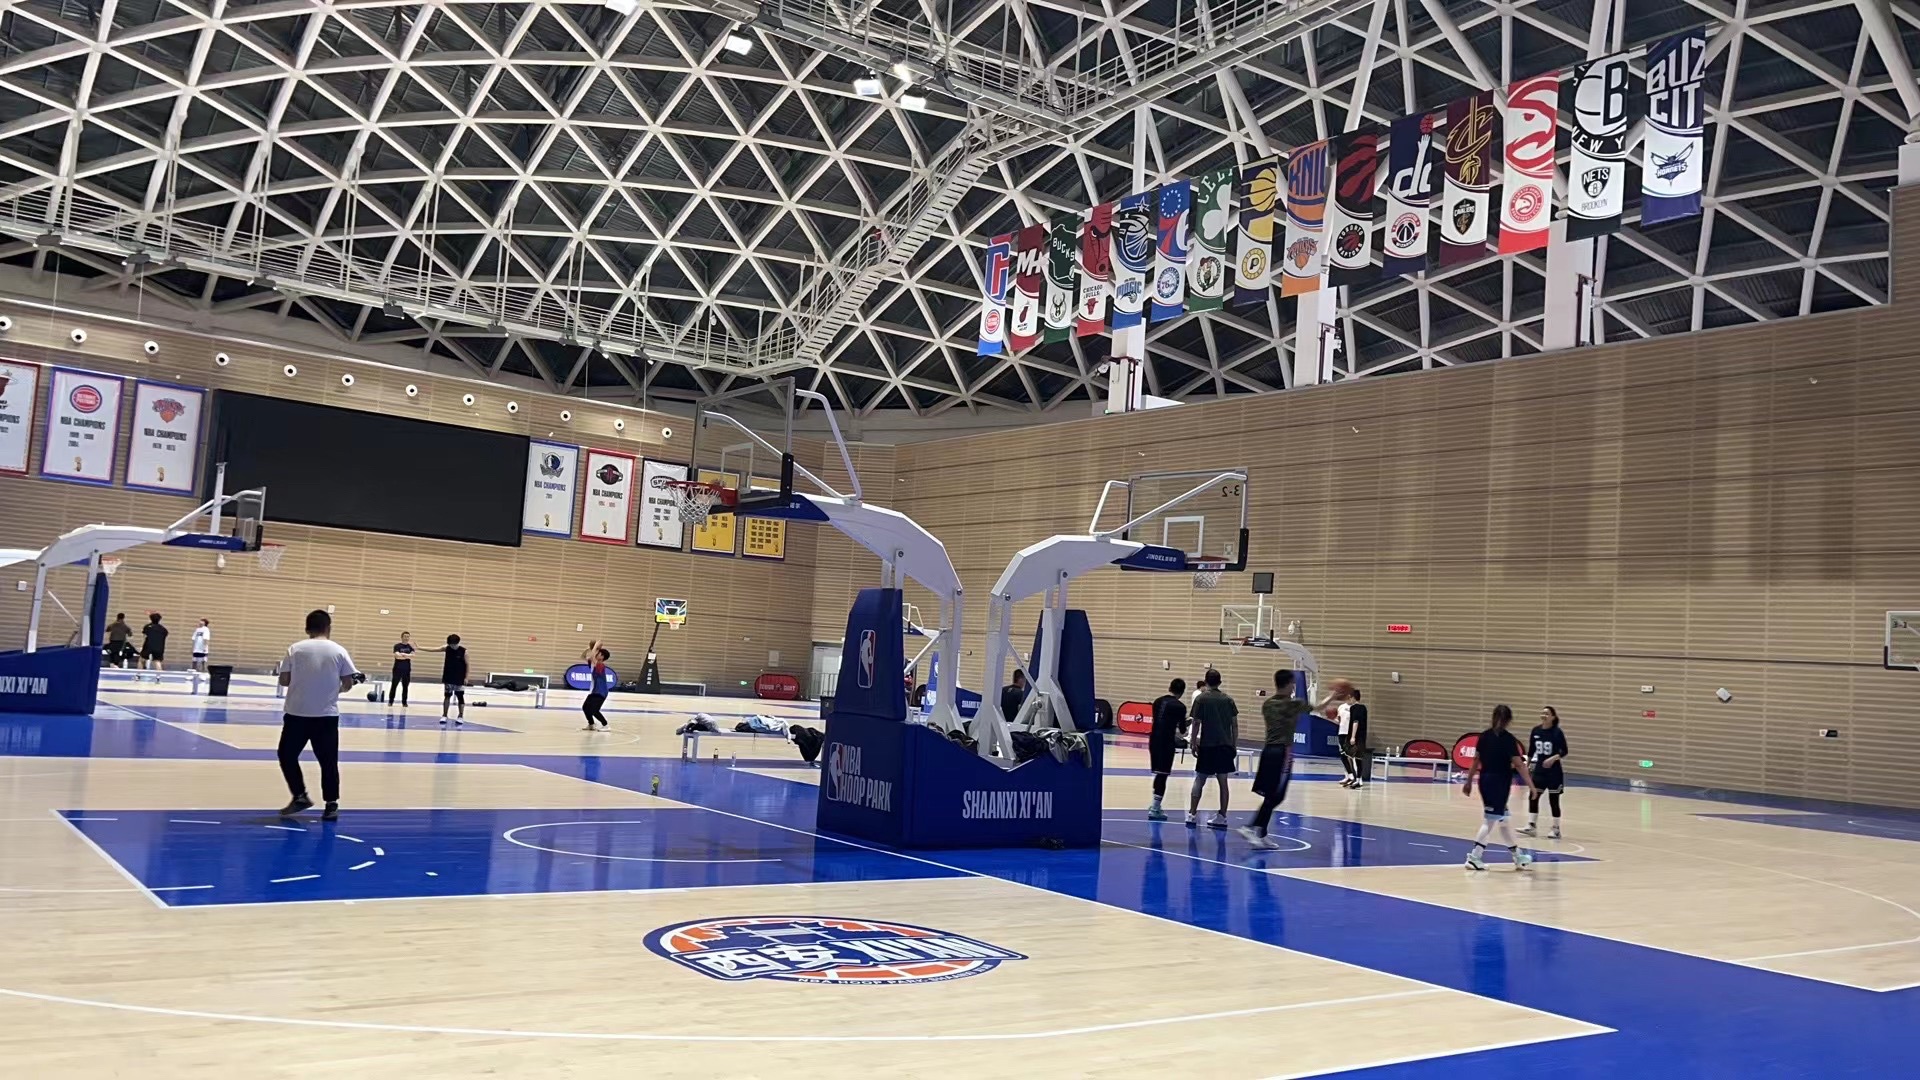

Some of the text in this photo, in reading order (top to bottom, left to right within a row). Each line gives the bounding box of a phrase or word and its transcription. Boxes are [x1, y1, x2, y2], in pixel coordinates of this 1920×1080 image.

[1583, 168, 1609, 185] NETS
[1656, 161, 1687, 178] HORNETS
[1338, 224, 1363, 240] TORONTO
[1052, 237, 1075, 261] BUCKS
[1338, 242, 1363, 258] RAPTORS
[1083, 284, 1103, 294] CHICAGO
[1116, 281, 1142, 299] MAGIC
[74, 418, 105, 430] CHAMPIONS
[157, 429, 187, 441] CHAMPIONS
[543, 482, 566, 492] CHAMPIONS
[602, 490, 623, 500] CHAMPIONS
[16, 677, 48, 694] XI'AN
[1535, 741, 1552, 754] 99
[842, 747, 861, 775] NBA
[840, 774, 893, 812] HOOP PARK
[962, 790, 1053, 819] SHAANXI XI'AN
[687, 941, 861, 976] 西安
